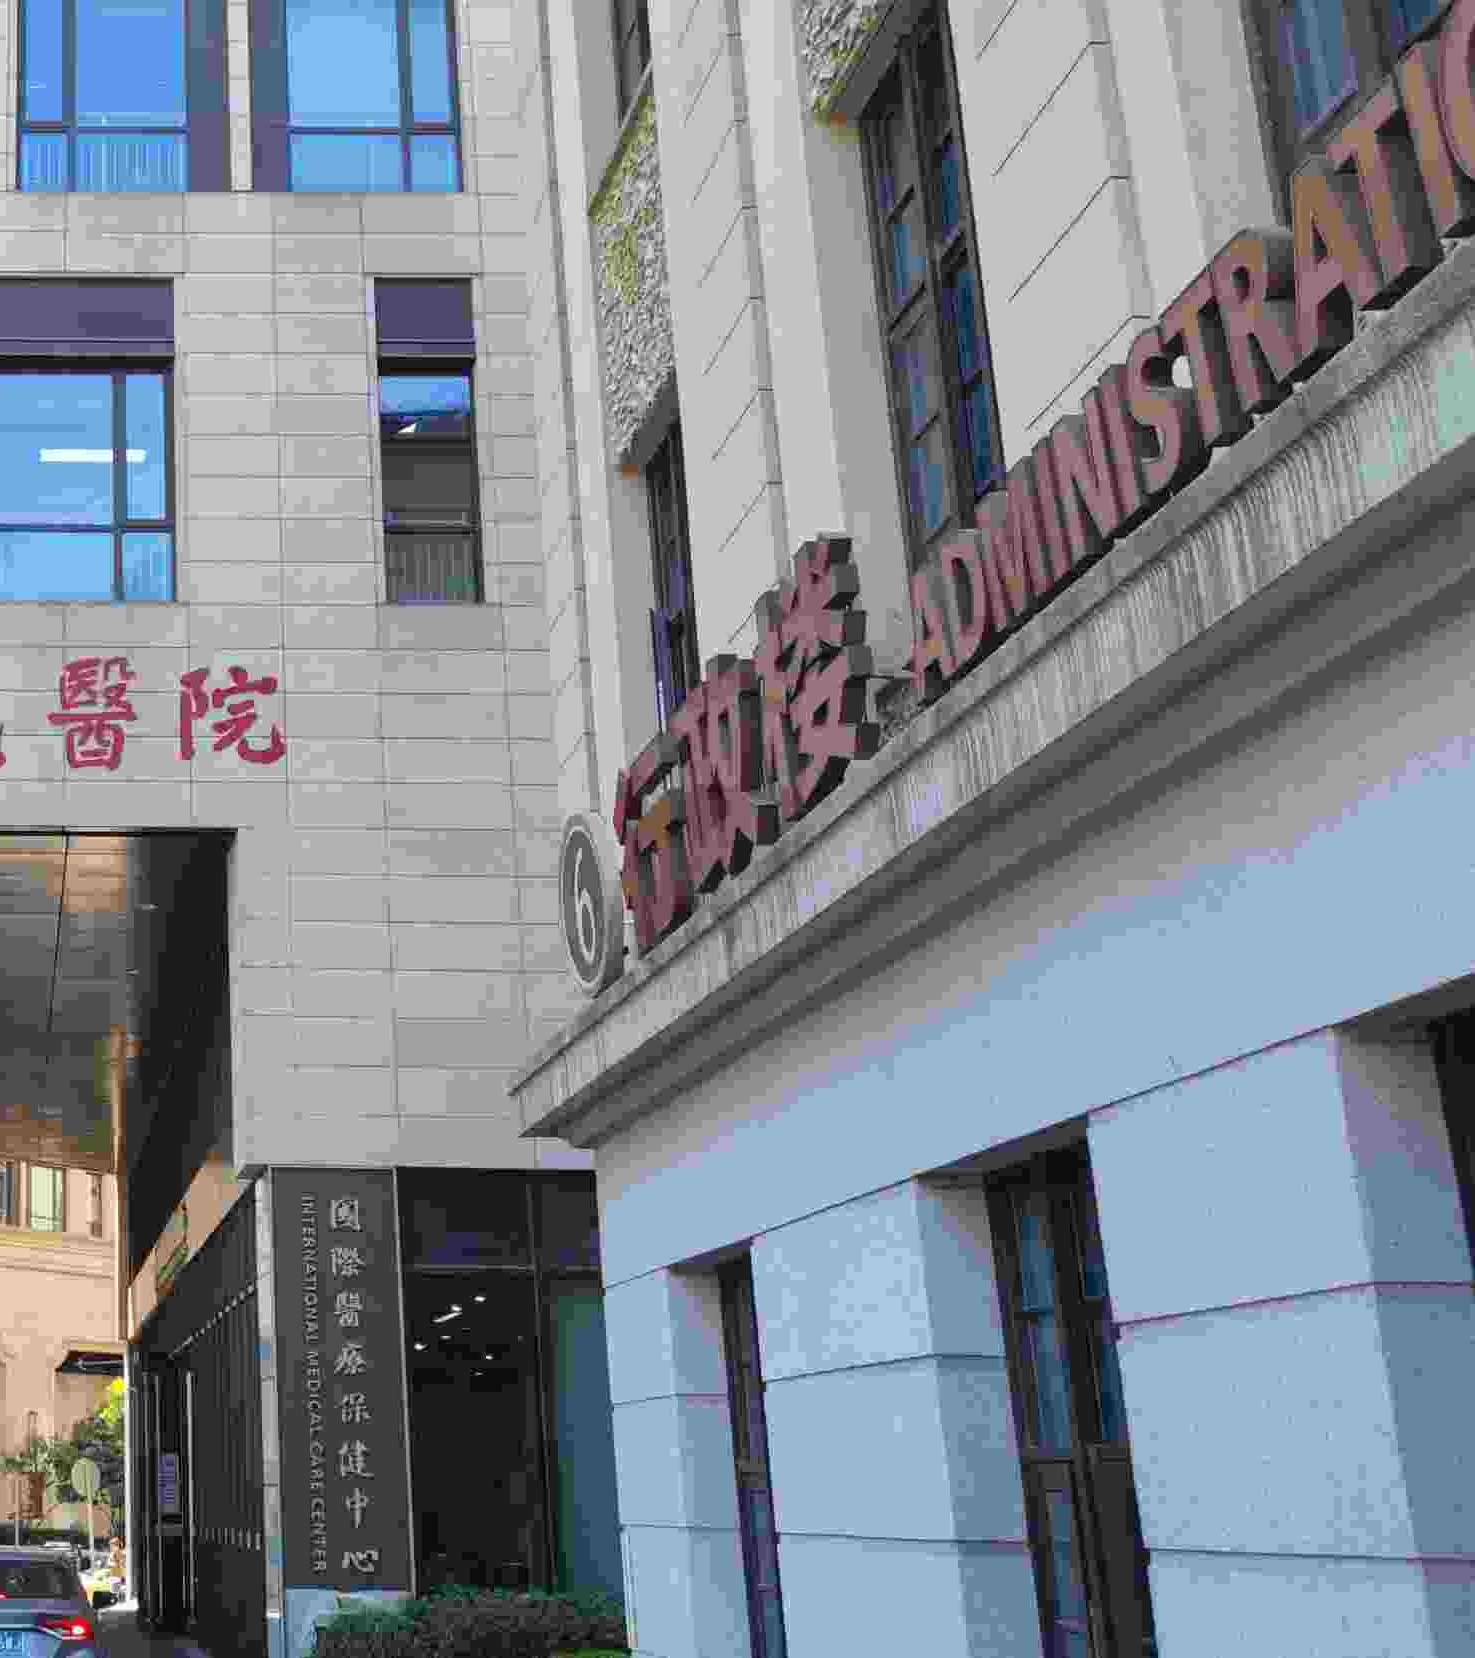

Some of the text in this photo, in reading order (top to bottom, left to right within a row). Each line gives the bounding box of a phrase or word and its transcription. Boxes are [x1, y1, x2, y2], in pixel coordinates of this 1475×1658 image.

[613, 536, 878, 948] 行政楼
[301, 1192, 327, 1576] INTERNATIONAL MEDICAL CARE CENTER
